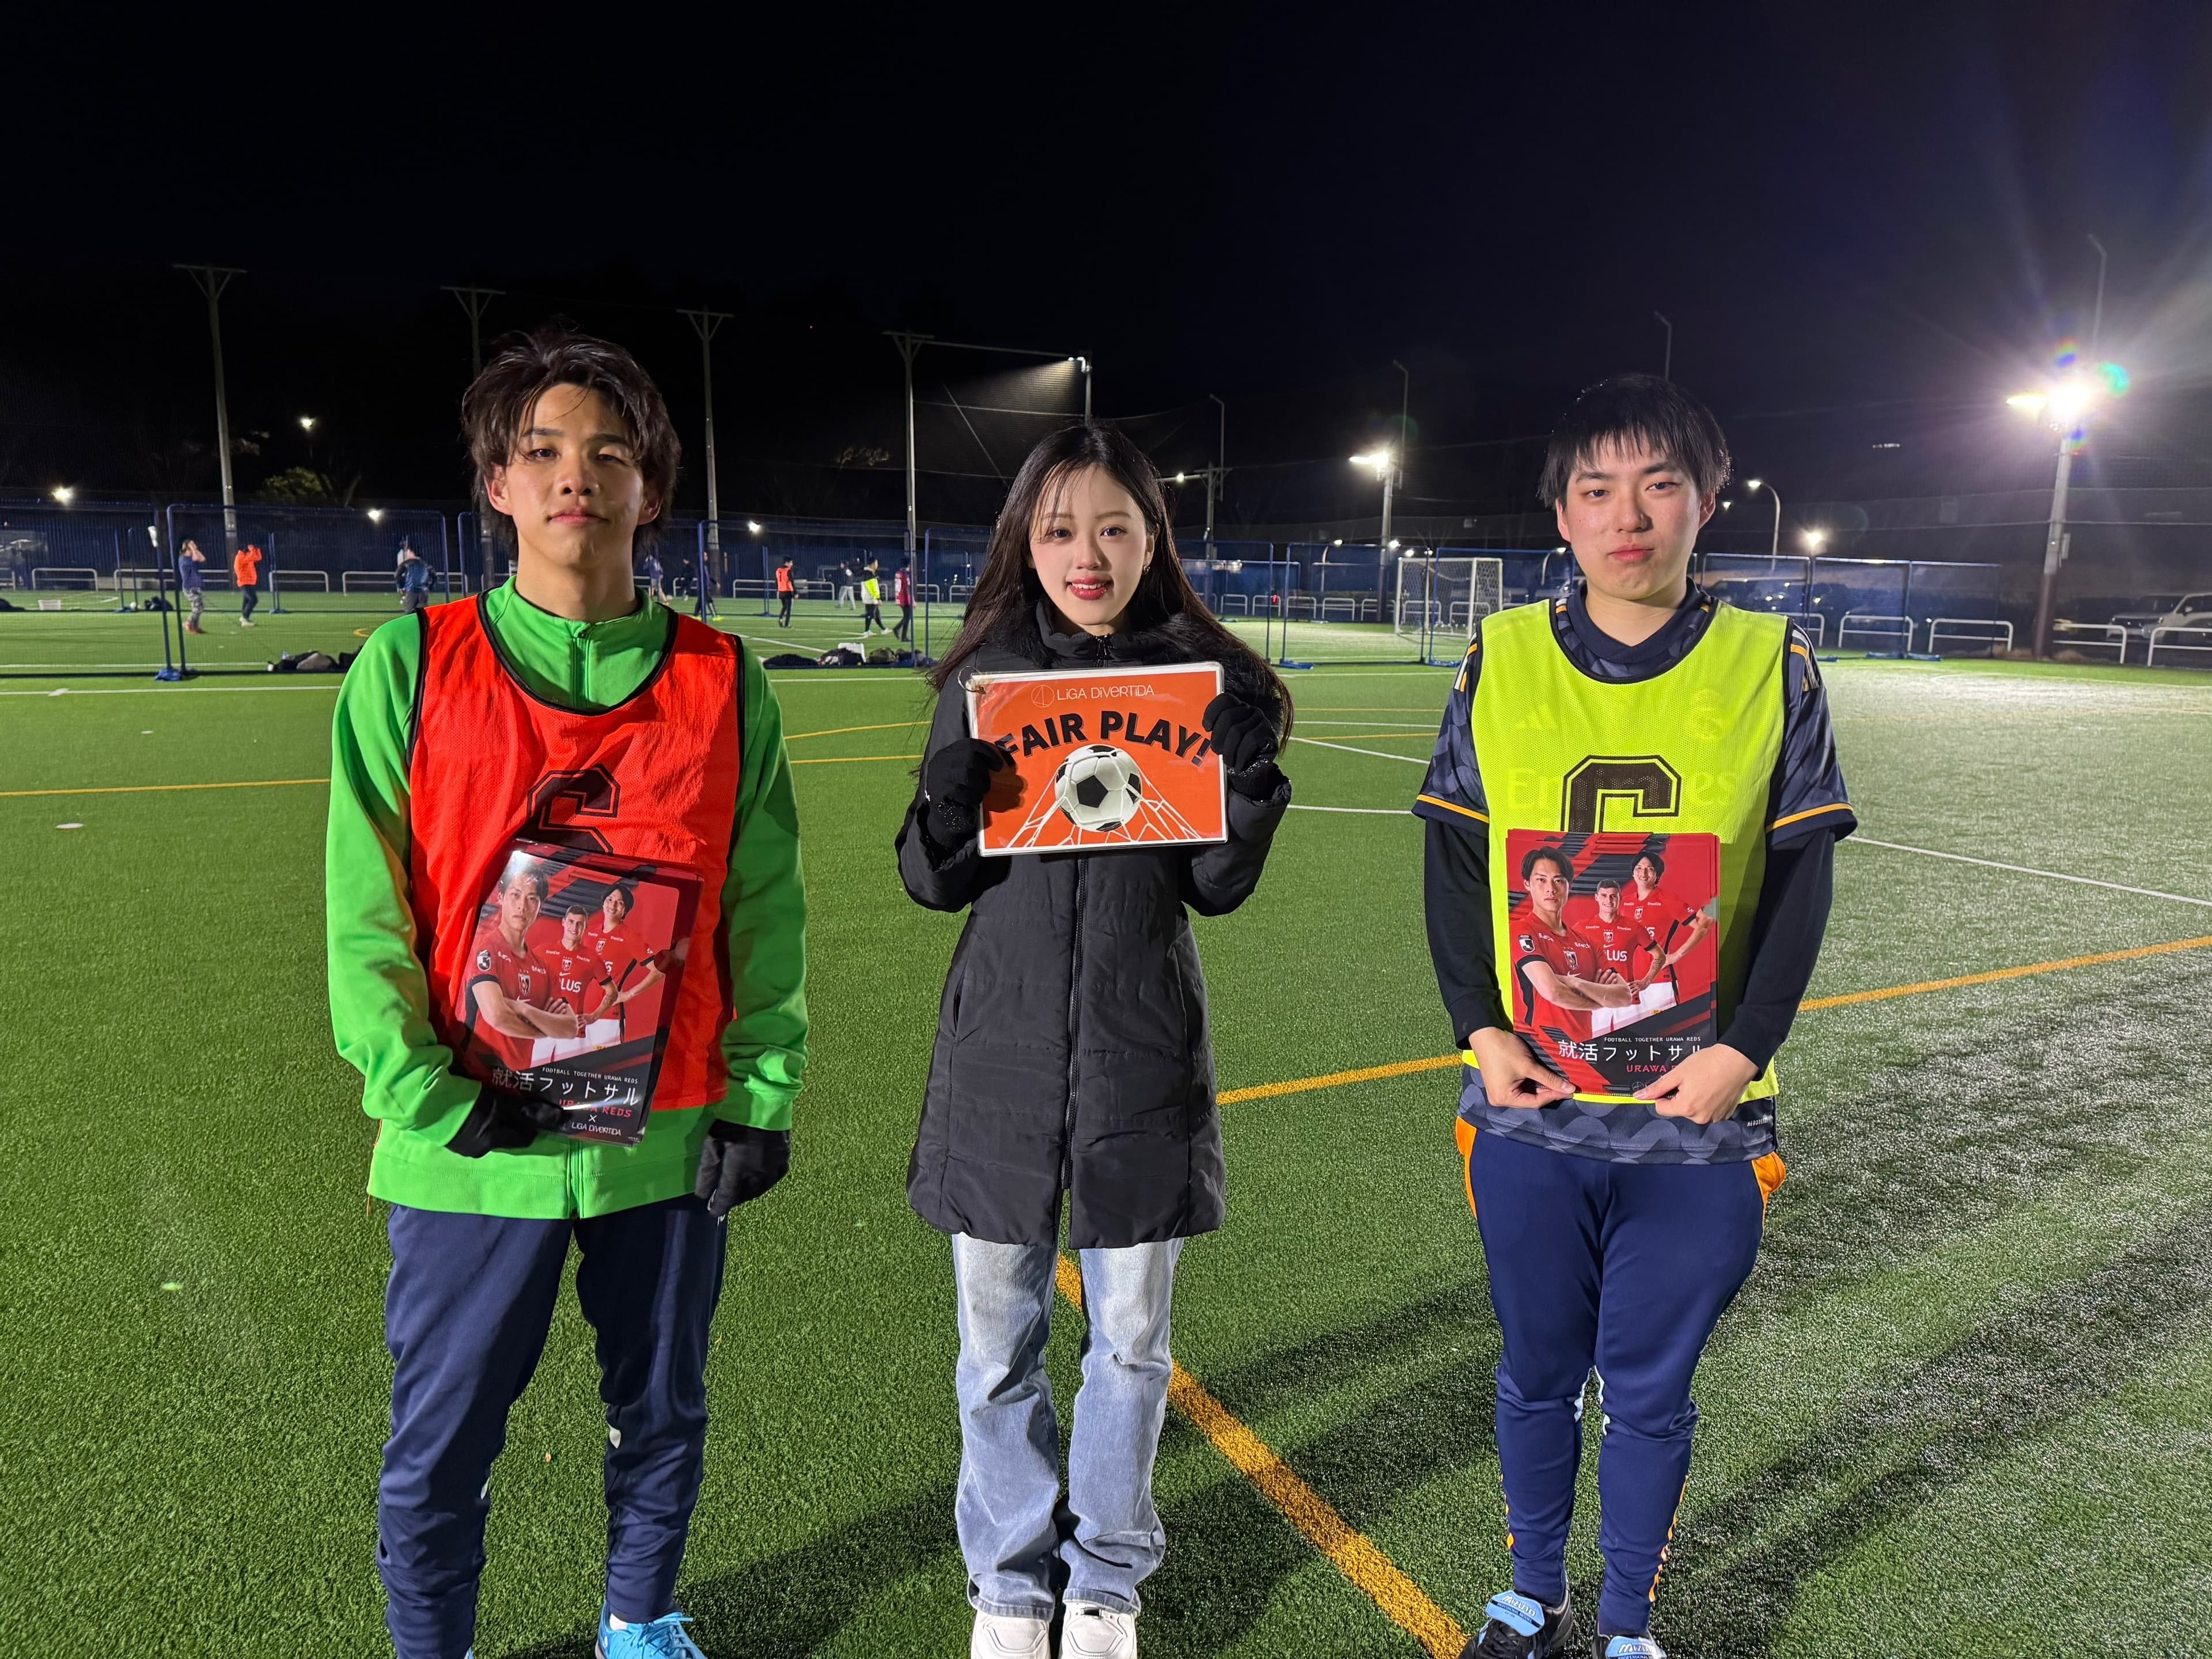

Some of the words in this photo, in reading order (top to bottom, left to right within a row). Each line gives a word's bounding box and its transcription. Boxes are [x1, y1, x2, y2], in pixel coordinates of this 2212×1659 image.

[1100, 710, 1211, 767] PLAY!
[1604, 950, 1627, 961] LUS
[559, 978, 581, 993] LUS
[542, 1067, 570, 1075] FOOTBALL
[574, 1070, 601, 1079] TOGETHER
[492, 1067, 639, 1106] 就活フットサル
[602, 1105, 632, 1118] REDS
